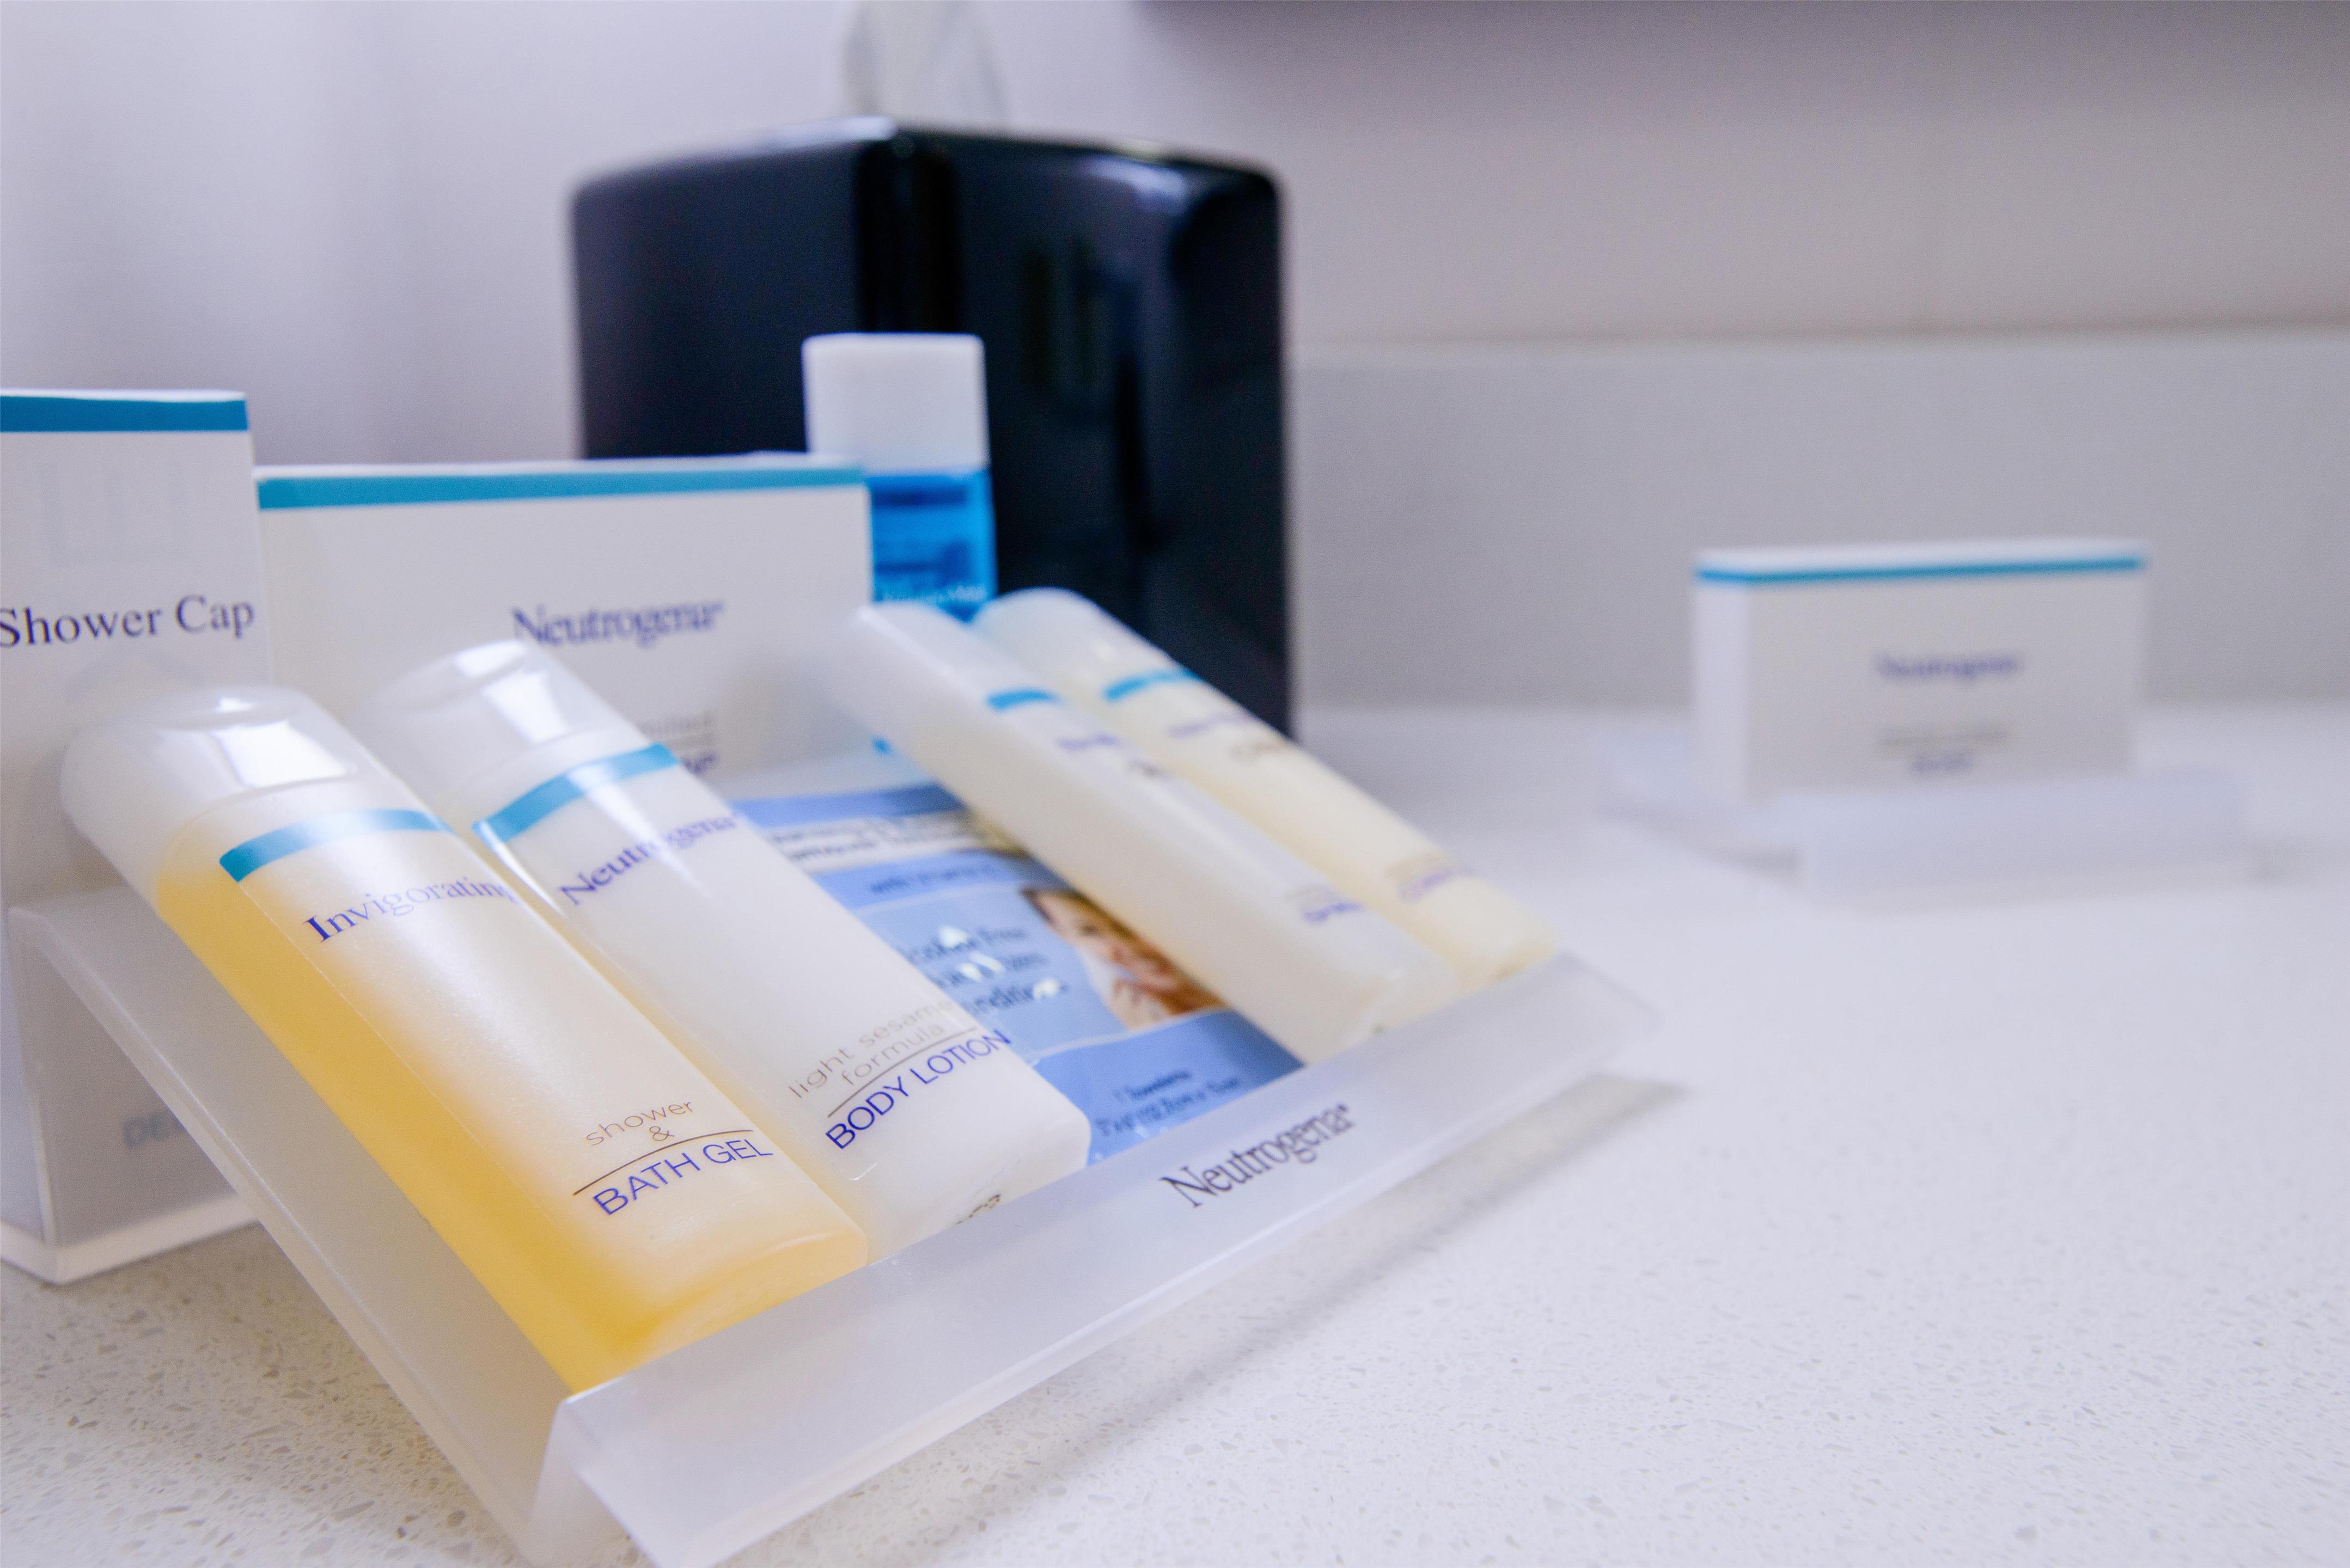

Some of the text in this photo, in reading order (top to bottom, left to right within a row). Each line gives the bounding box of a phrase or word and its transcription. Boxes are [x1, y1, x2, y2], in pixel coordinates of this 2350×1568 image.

[0, 595, 255, 648] Shower Cap
[789, 1046, 855, 1099] light
[841, 1023, 944, 1086] formula
[825, 1028, 1011, 1150] BODY LOTION
[585, 1101, 693, 1146] shower
[648, 1125, 675, 1142] &
[593, 1138, 774, 1215] BATH GEL
[1158, 1104, 1354, 1208] Neutrogena
